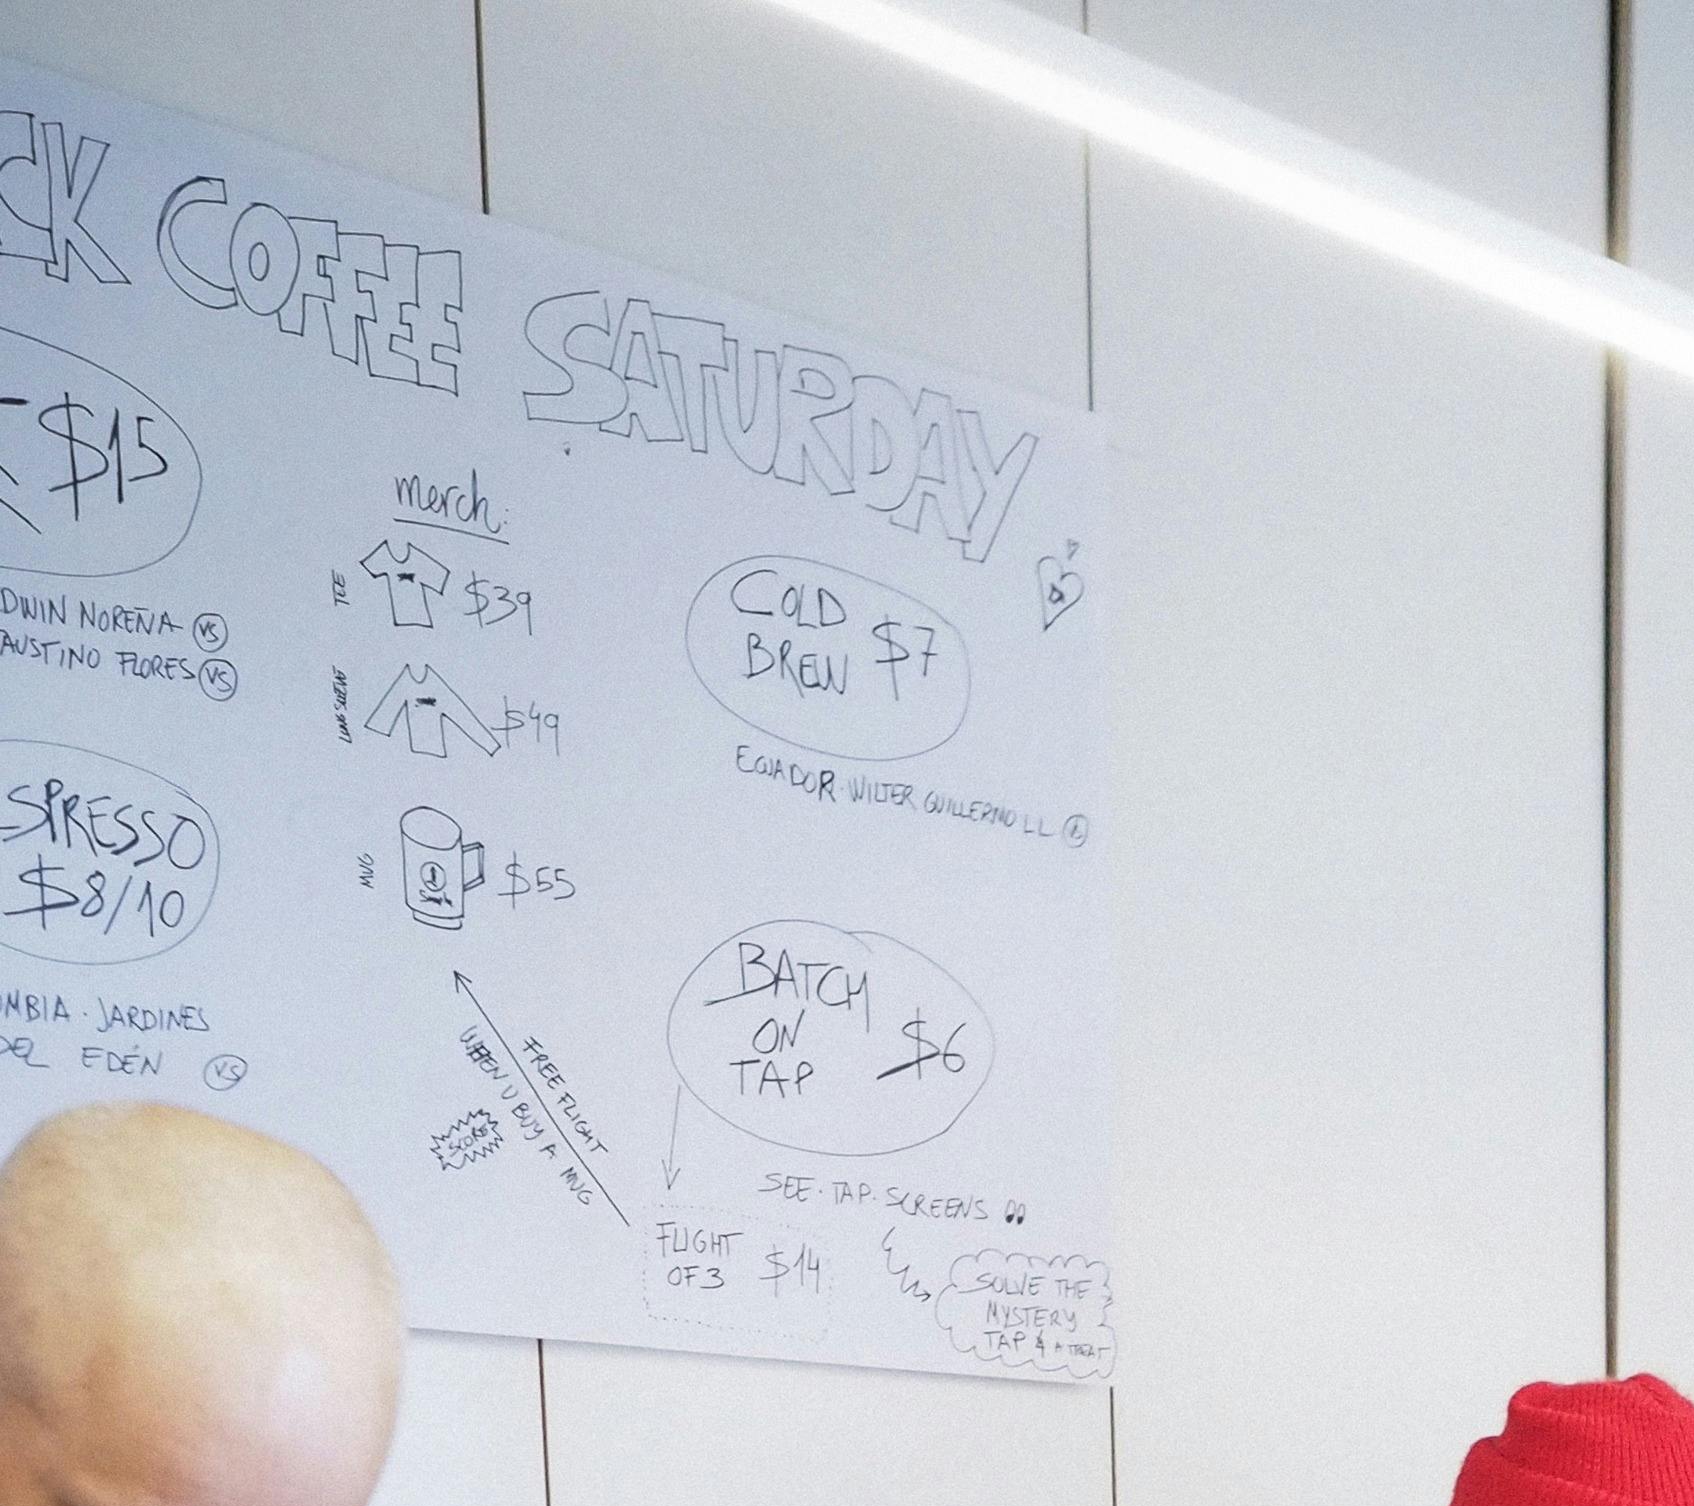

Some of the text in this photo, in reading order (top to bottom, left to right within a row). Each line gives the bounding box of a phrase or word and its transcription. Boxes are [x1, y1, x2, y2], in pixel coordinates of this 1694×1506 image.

[157, 176, 462, 397] COFFEE
[523, 291, 1039, 562] SATURDAY
[38, 392, 168, 522] $15
[80, 600, 183, 635] NOREÑA
[464, 570, 532, 635] $39
[731, 569, 847, 628] COLD
[115, 652, 196, 680] FLORES
[743, 614, 938, 700] BREW $7
[491, 695, 560, 756] $49
[0, 778, 205, 869] SPRESSO
[3, 853, 184, 937] $8/10
[498, 851, 576, 909] $55
[97, 997, 210, 1032] JARDINES
[703, 942, 870, 1033] BATCH
[729, 1007, 967, 1098] TAP $6
[752, 1009, 804, 1053] ON
[459, 1025, 509, 1080] WHEN
[511, 1102, 544, 1141] BUY
[539, 1144, 556, 1159] A
[523, 1036, 608, 1153] FREE FLIGHT
[886, 1187, 989, 1220] SCREENS
[656, 1222, 744, 1258] FLIGHT
[758, 1243, 820, 1297] $14
[958, 1272, 1093, 1300] SOLVE THE
[983, 1330, 1026, 1352] TAP
[986, 1300, 1078, 1333] MYSTERY
